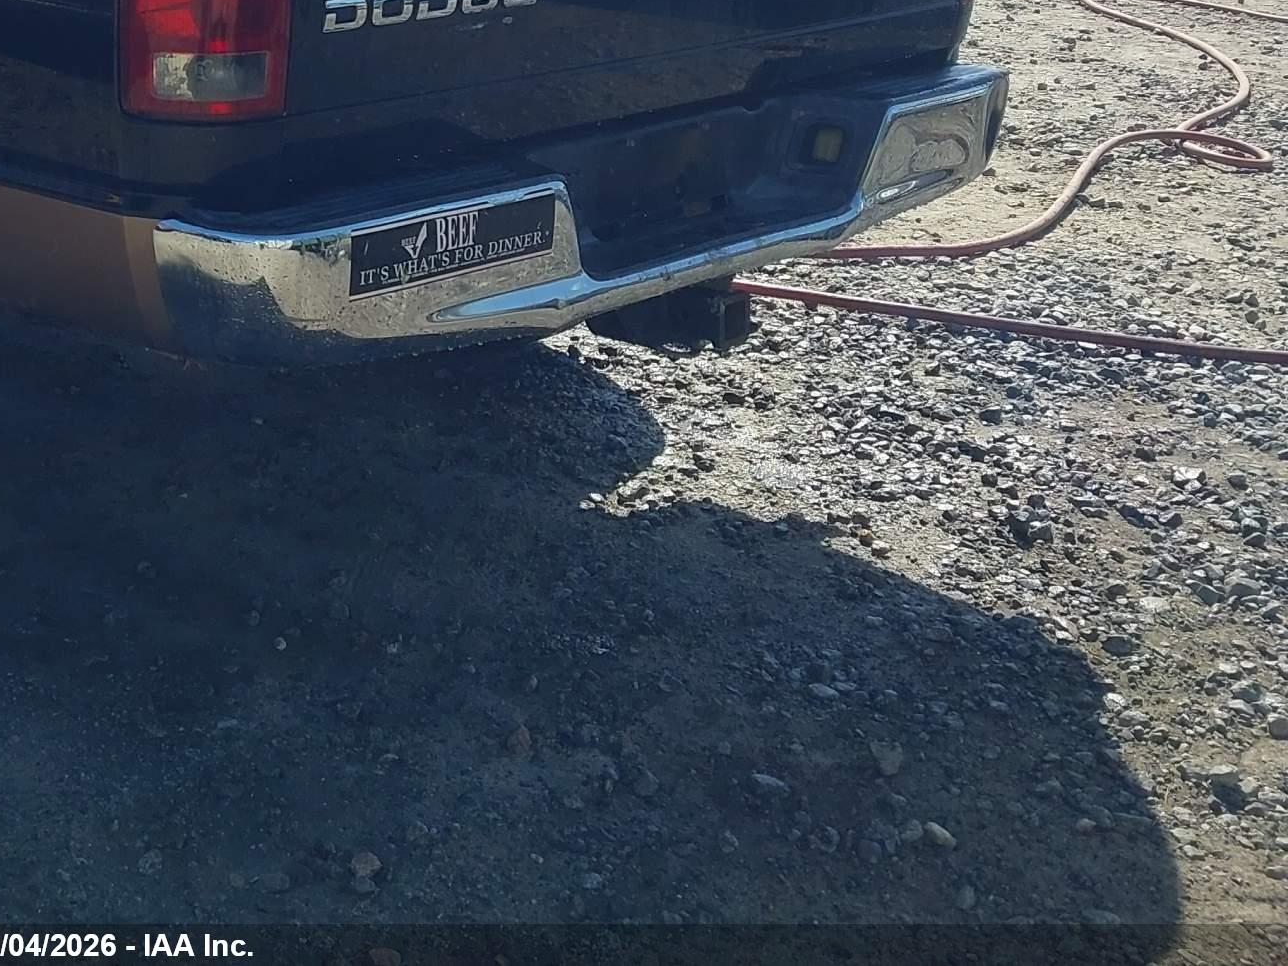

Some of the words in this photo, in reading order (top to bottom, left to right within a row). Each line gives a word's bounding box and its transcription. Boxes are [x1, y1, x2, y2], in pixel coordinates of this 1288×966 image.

[436, 211, 479, 253] BEEF
[359, 266, 390, 286] IT'S
[393, 251, 450, 280] WHAT'S
[455, 243, 483, 263] FOR
